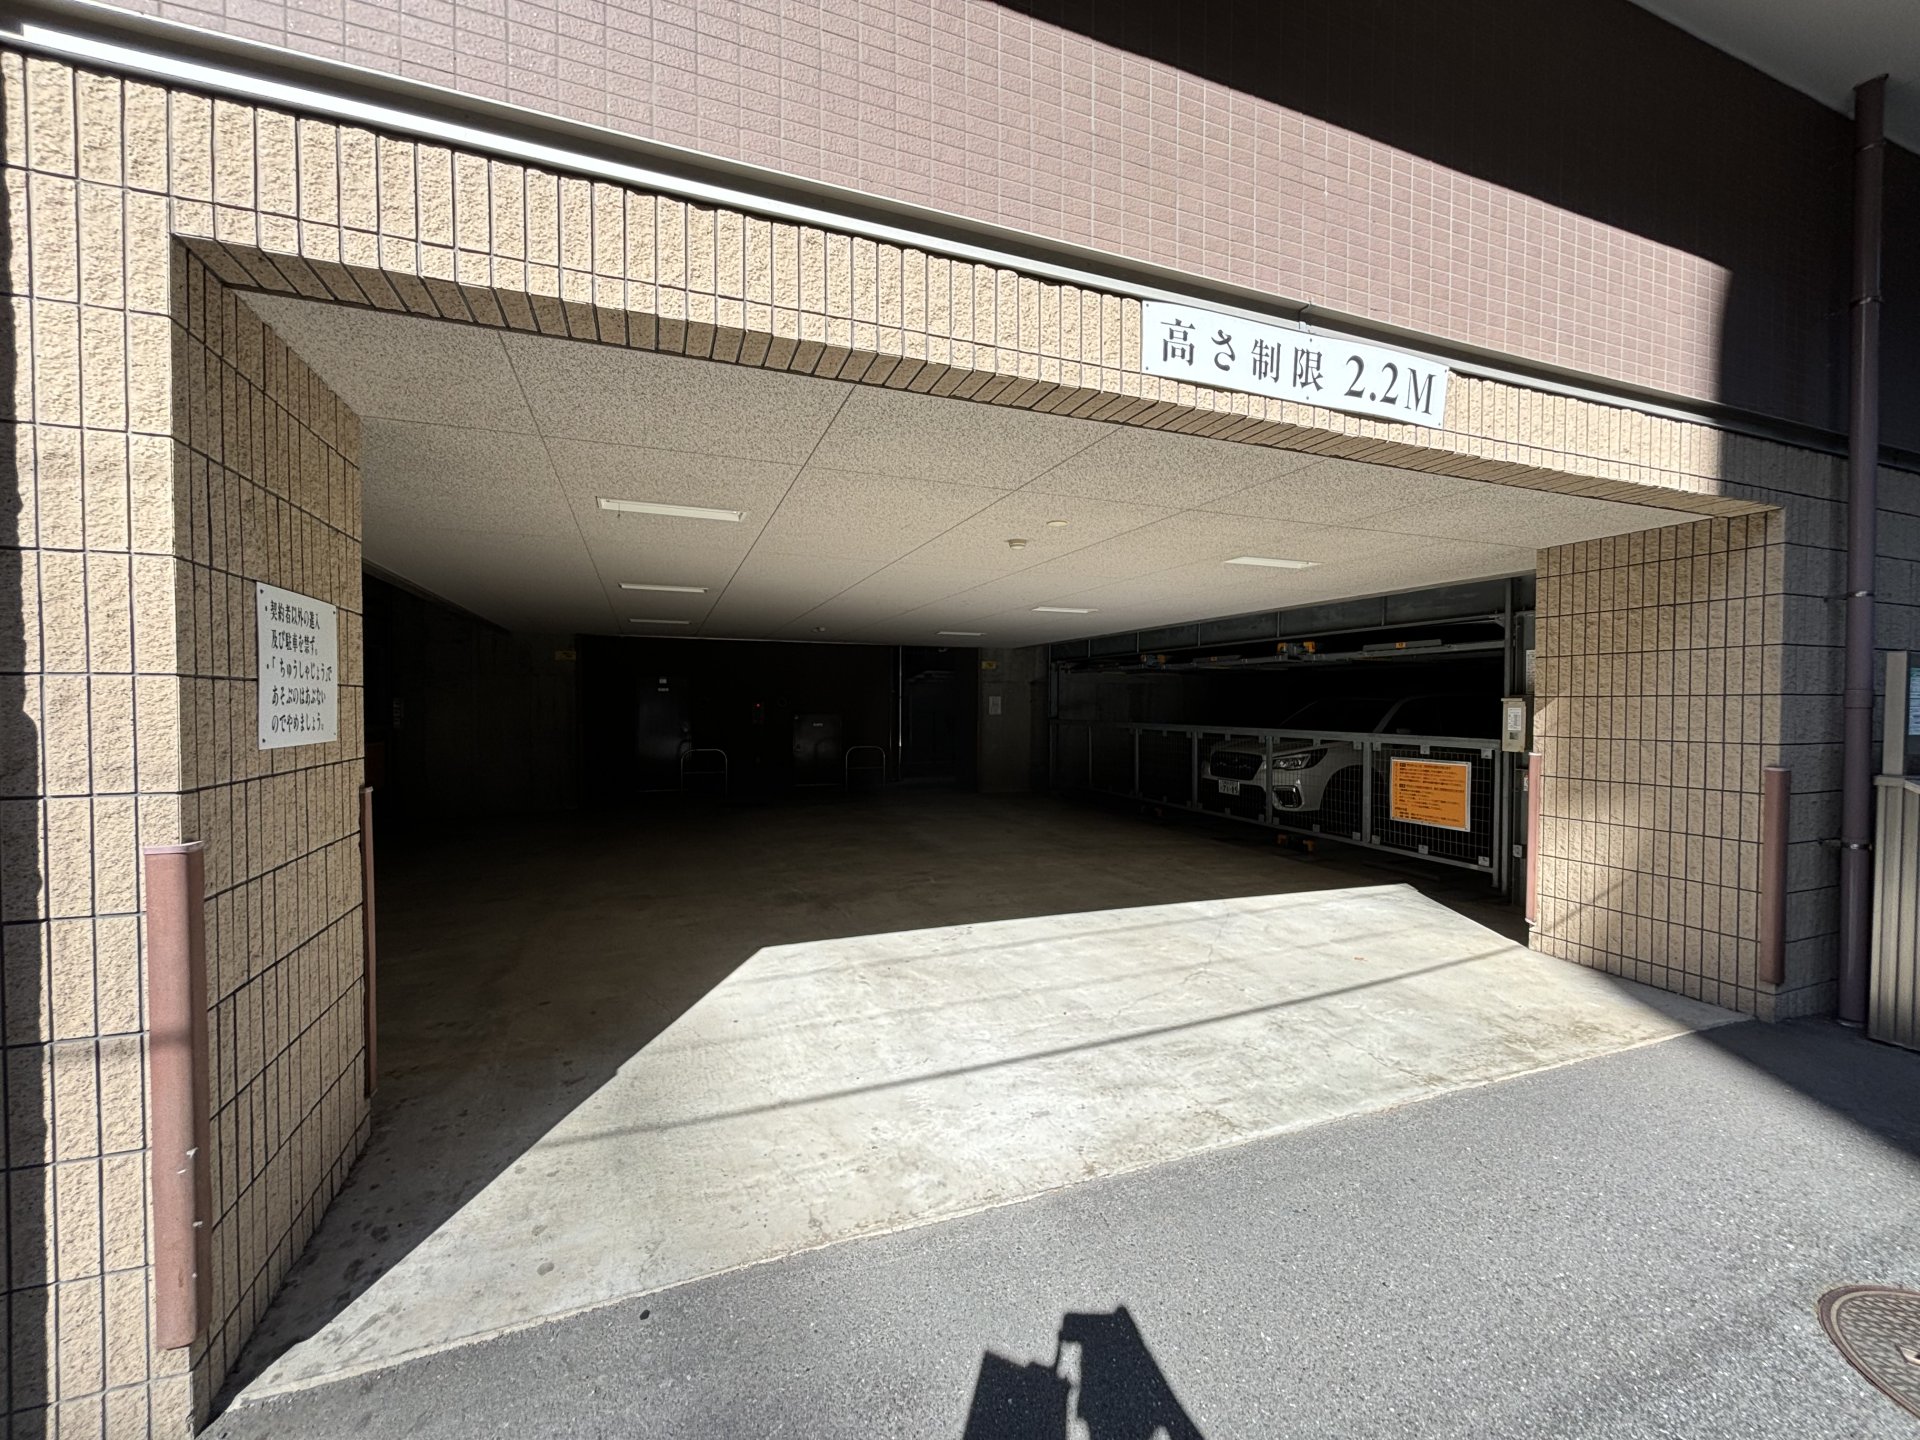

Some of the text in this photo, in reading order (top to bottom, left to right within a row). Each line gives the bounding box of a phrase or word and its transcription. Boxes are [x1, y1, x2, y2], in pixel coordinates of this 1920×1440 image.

[1160, 318, 1437, 415] 高さ制限 2.2M
[271, 686, 326, 706] あそぶのはあぶない
[271, 712, 325, 733] のでやめましょう。
